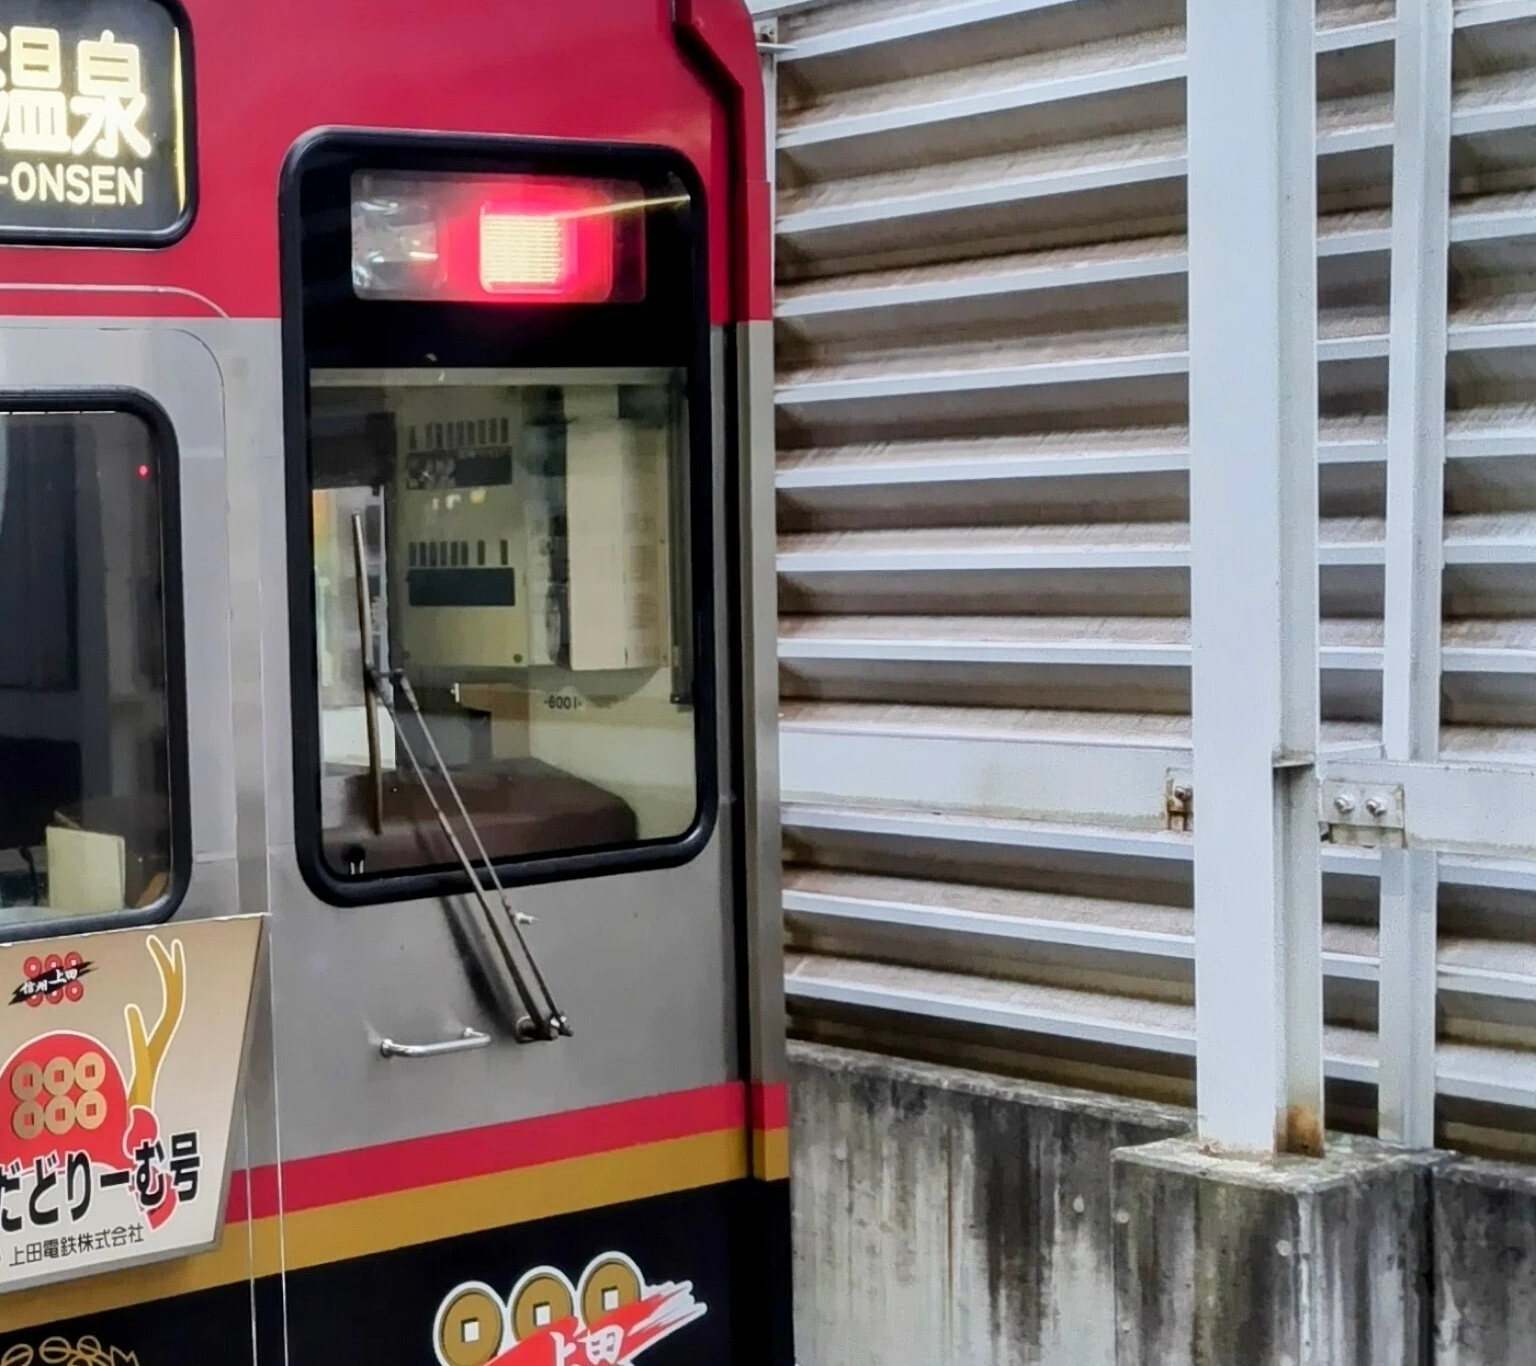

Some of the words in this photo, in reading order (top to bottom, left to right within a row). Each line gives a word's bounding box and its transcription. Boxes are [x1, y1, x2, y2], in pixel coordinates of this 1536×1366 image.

[20, 968, 78, 995] 信州上田
[9, 1223, 144, 1266] 上田電鉄株式会社
